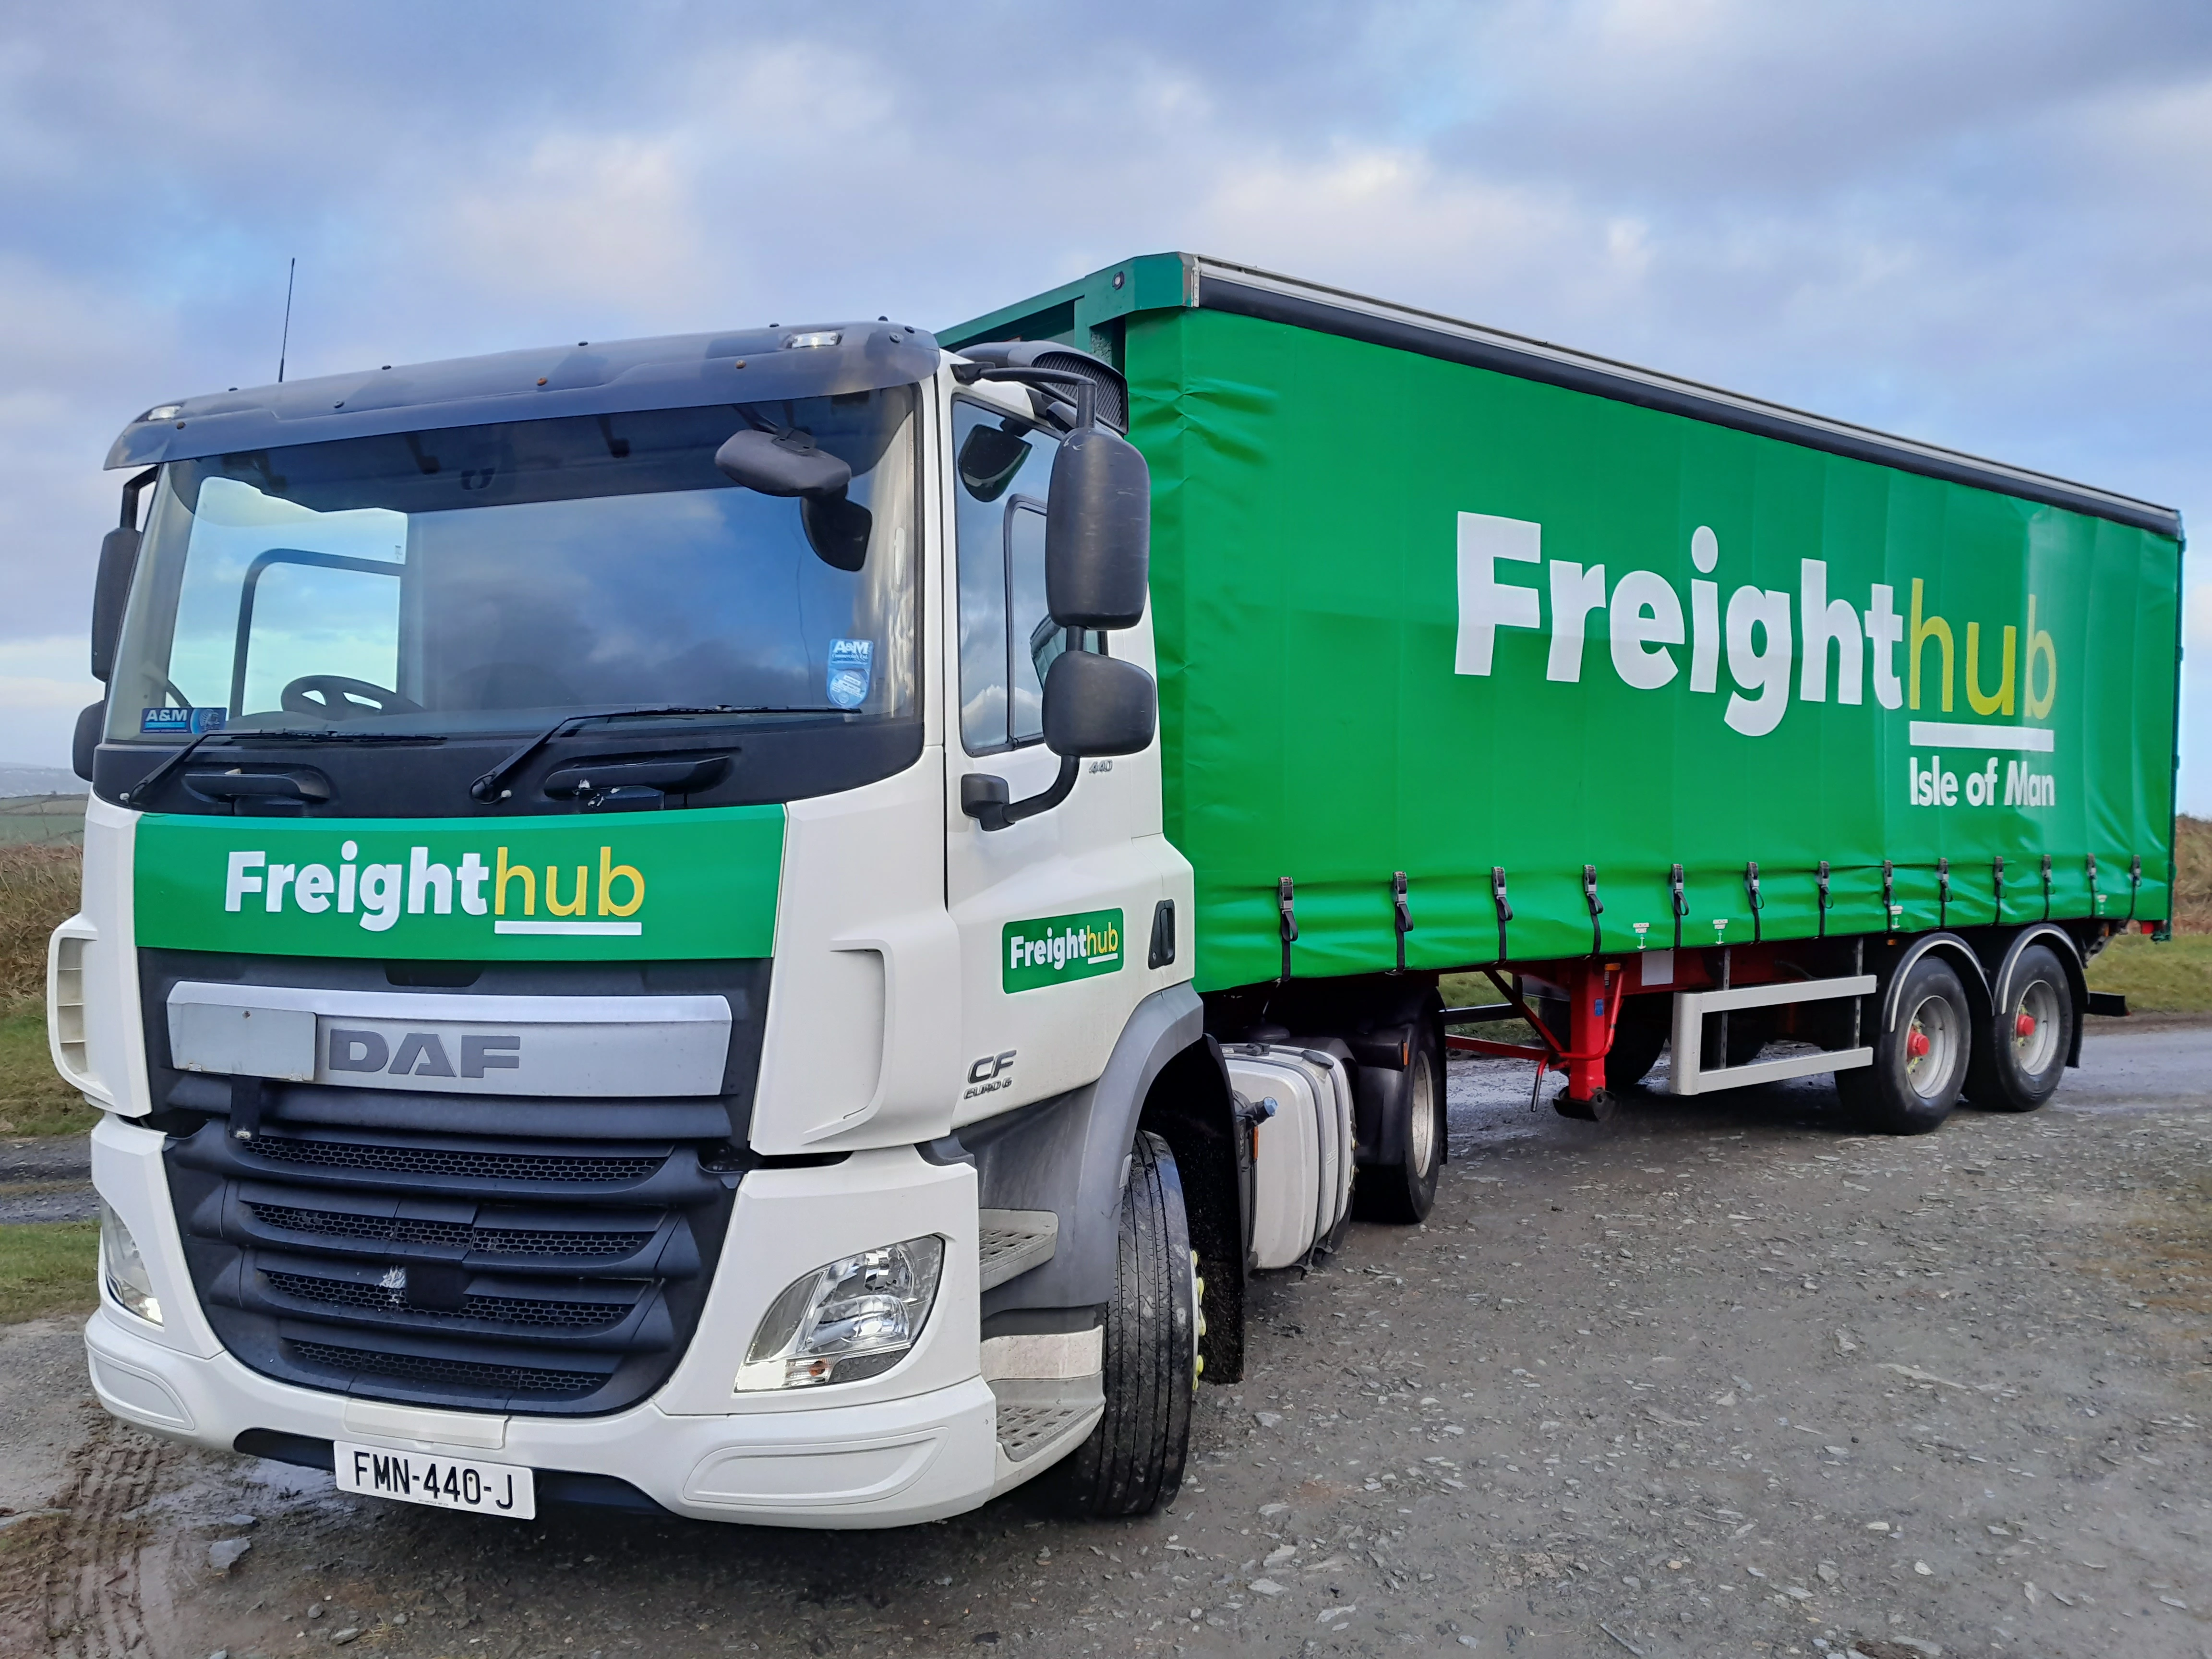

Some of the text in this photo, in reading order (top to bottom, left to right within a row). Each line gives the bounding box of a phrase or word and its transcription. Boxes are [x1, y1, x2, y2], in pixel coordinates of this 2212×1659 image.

[833, 640, 869, 654] A&M
[1455, 511, 2056, 736] Freighthub
[145, 709, 187, 721] A&M
[1089, 759, 1113, 773] 440
[1910, 756, 2055, 807] Isle of Man
[226, 841, 645, 932] Freighthub
[1010, 922, 1118, 970] Freighthub
[328, 1027, 520, 1079] DAF
[967, 1050, 1017, 1084] CF
[963, 1077, 1012, 1100] EURO 6
[354, 1451, 513, 1510] FMN-440-J
